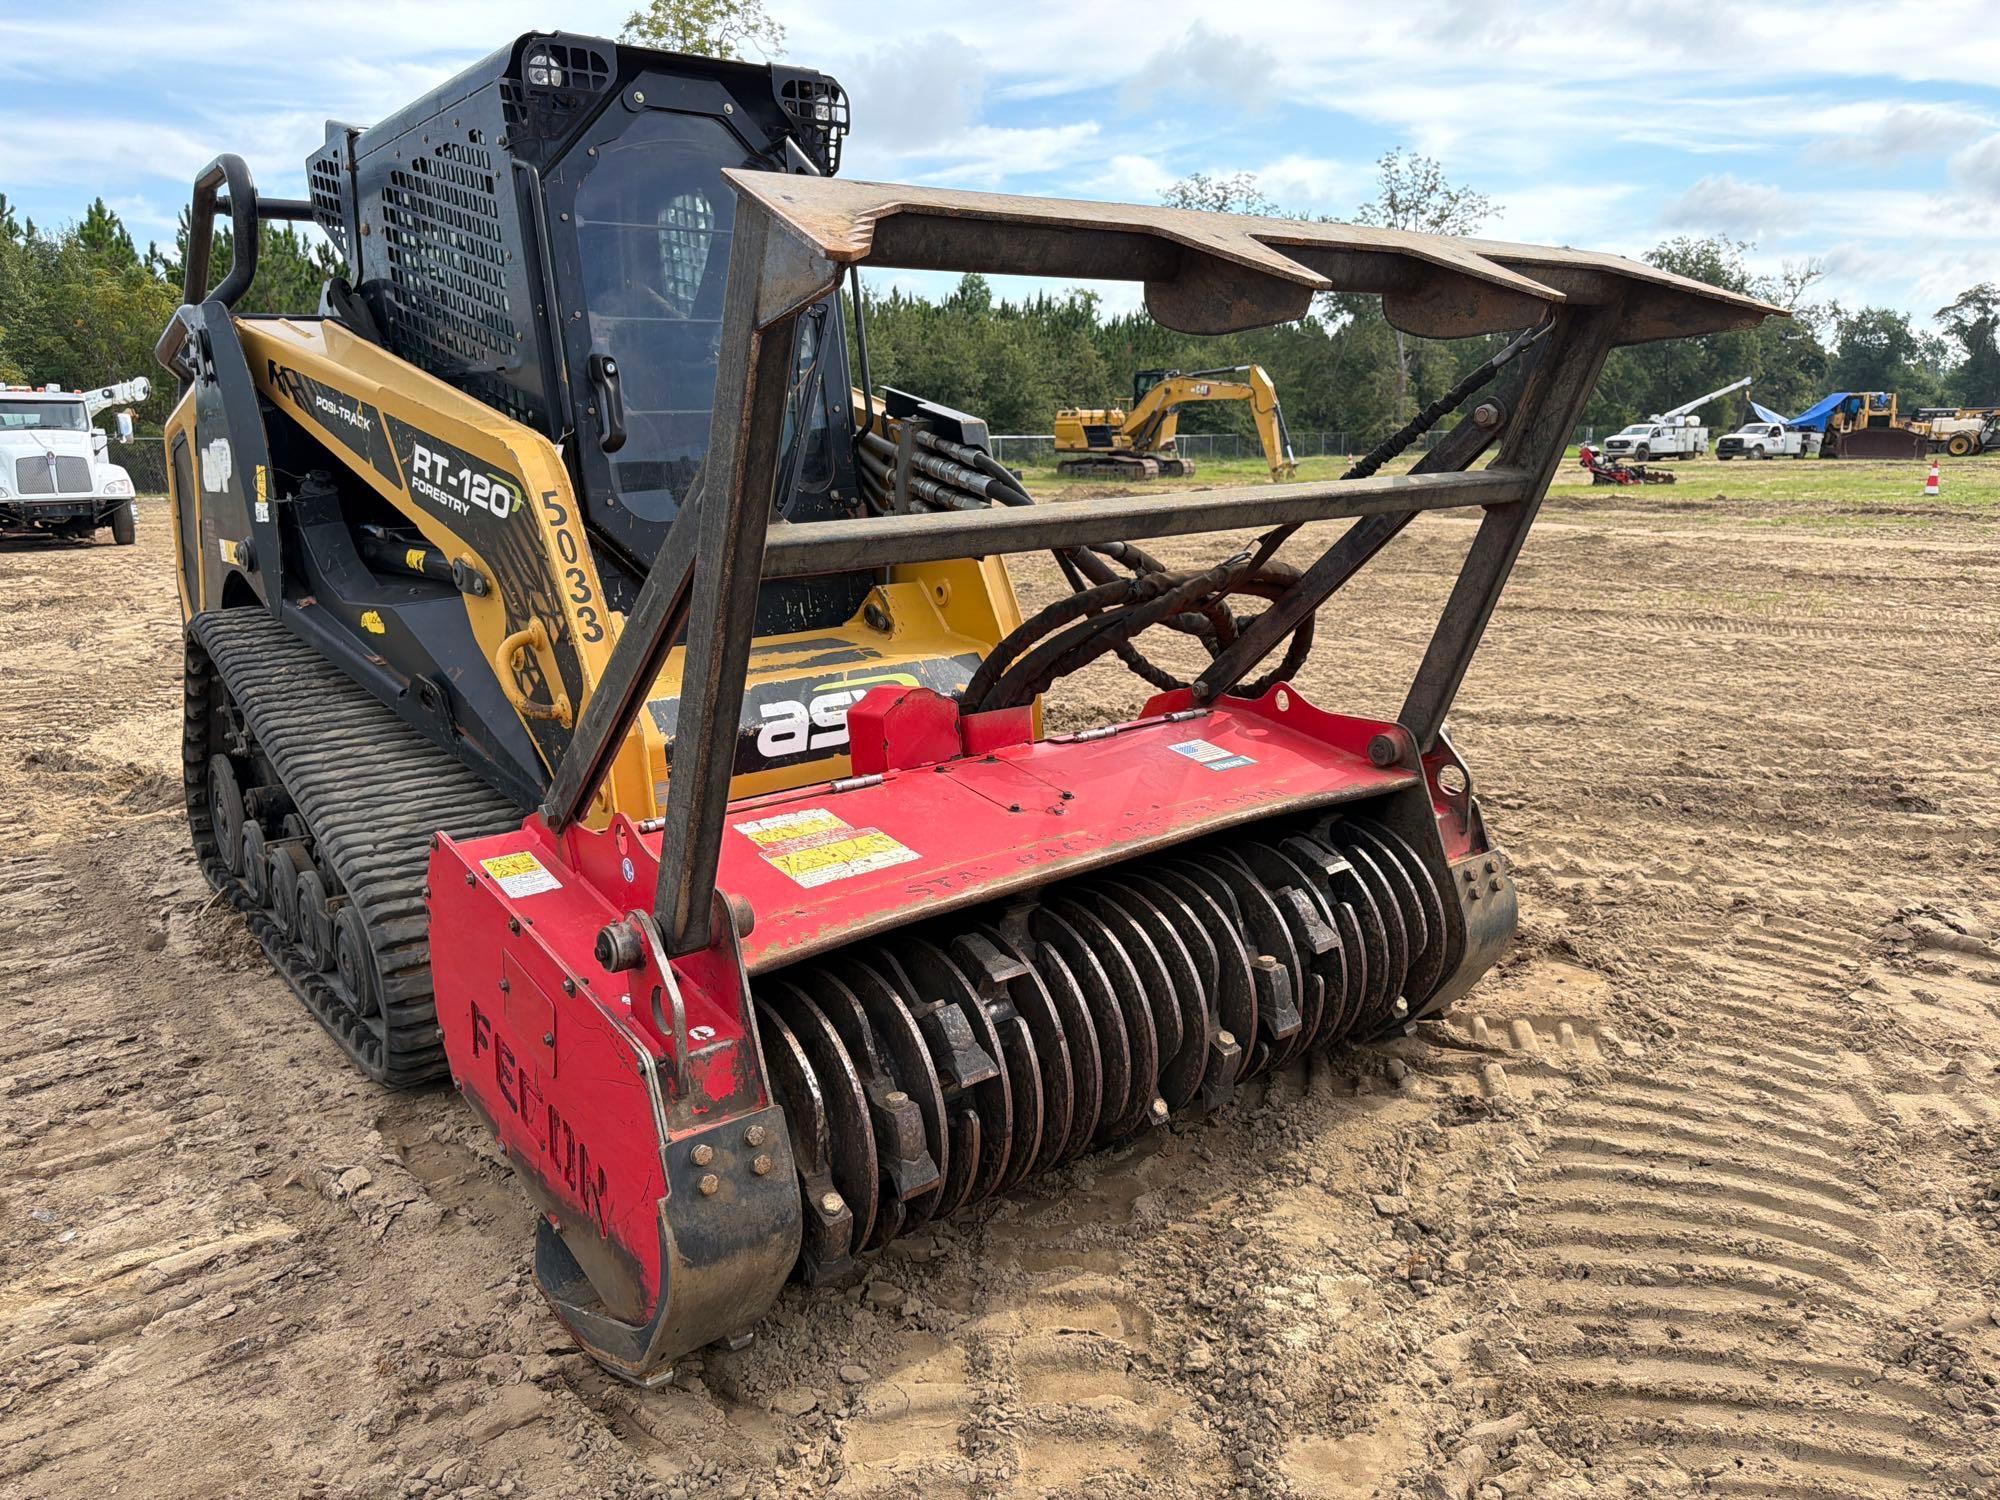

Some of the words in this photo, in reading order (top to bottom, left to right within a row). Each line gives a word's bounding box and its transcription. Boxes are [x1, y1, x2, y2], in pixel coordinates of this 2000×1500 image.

[315, 395, 371, 432] POSI-TRACK
[411, 475, 471, 516] FORESTRY
[413, 444, 511, 519] RT-120
[541, 490, 604, 643] 5033
[757, 689, 868, 757] as
[470, 999, 608, 1239] FECON
